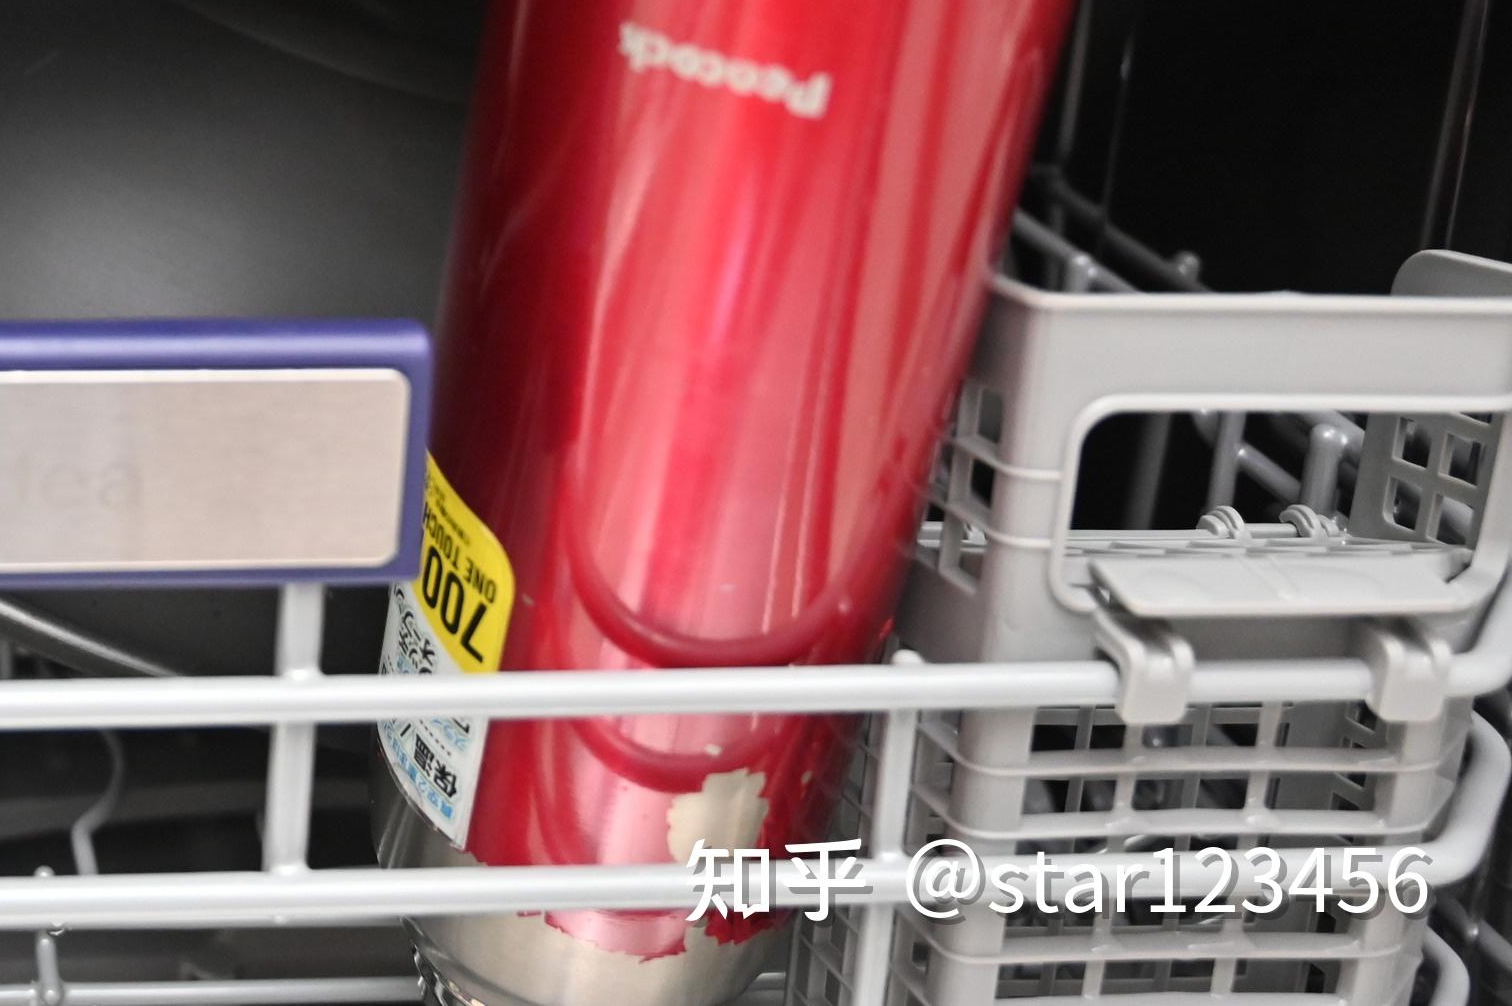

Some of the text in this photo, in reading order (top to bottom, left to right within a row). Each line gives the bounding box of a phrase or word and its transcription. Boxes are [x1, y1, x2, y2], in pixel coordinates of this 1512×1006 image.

[618, 22, 832, 119] Peacock
[423, 501, 460, 570] TOUCH
[422, 546, 486, 663] 700
[463, 556, 497, 604] ONE
